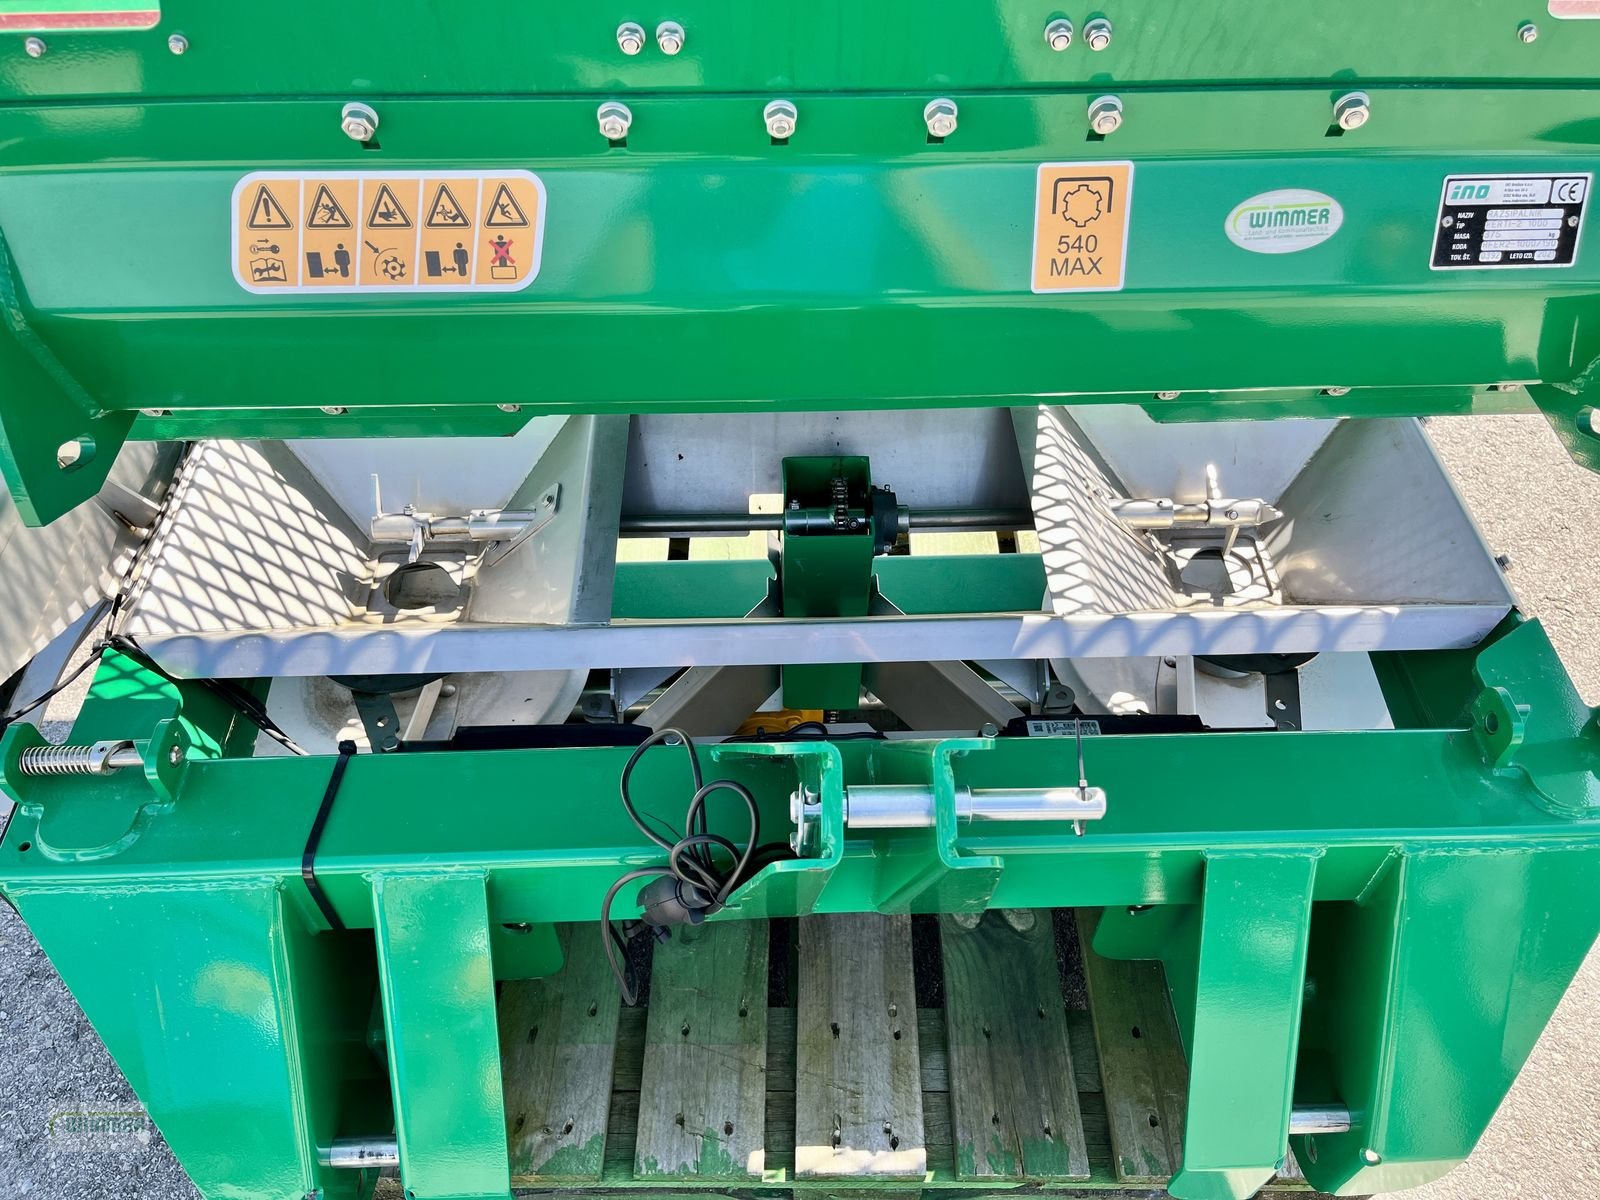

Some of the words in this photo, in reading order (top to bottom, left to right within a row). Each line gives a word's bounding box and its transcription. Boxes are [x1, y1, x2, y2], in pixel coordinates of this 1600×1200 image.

[1558, 182, 1580, 201] CE
[1249, 208, 1331, 229] WIMMER
[1457, 211, 1474, 219] NAZIV
[1487, 209, 1543, 218] RAZSIPALNIK
[1527, 220, 1549, 228] 1000
[1057, 234, 1098, 254] 540
[1050, 256, 1103, 277] MAX
